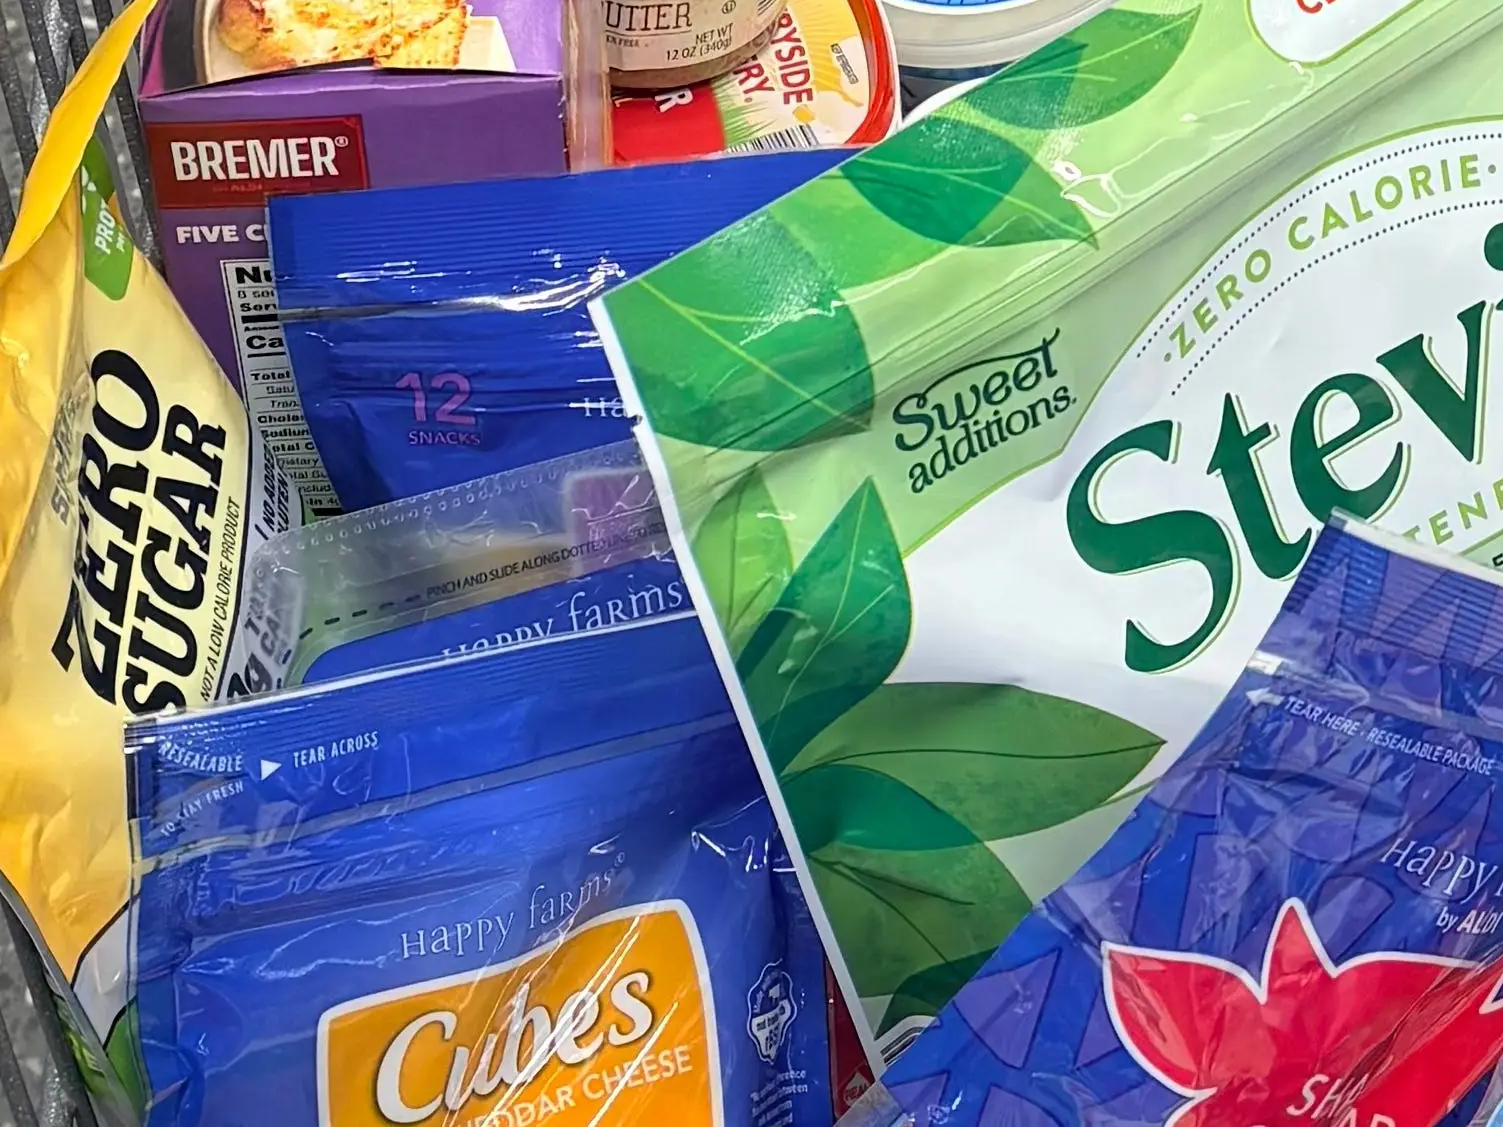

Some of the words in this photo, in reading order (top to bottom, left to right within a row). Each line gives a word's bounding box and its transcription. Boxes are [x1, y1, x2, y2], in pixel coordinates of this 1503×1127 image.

[666, 47, 681, 61] 12
[682, 45, 698, 59] OZ
[695, 31, 717, 45] NET
[718, 22, 734, 41] WT
[170, 135, 340, 182] BREMER
[175, 224, 239, 244] FIVE
[1169, 245, 1275, 361] ZERO
[1286, 151, 1484, 254] CALORIE
[394, 370, 477, 427] 12
[891, 327, 1063, 453] Sweet
[408, 430, 481, 446] SNACKS
[51, 348, 162, 707] ZERO
[225, 496, 241, 566] PRODUCT
[122, 403, 228, 720] SUGAR
[425, 580, 462, 599] PINCH
[462, 573, 488, 590] AND
[489, 562, 521, 582] SLIDE
[521, 551, 560, 570] ALONG
[217, 567, 234, 629] CALORIE
[211, 627, 226, 659] LOW
[200, 673, 214, 702] NOT
[157, 736, 244, 773] RESEALABLE
[292, 746, 327, 769] TEAR
[330, 729, 380, 760] ACROSS
[1285, 694, 1322, 726] TEAR
[1322, 707, 1362, 739] HERE
[1366, 726, 1443, 765] RESEALABLE
[1441, 746, 1498, 778] PACKAGE
[159, 821, 174, 838] TO
[204, 780, 245, 810] FRESH
[1435, 906, 1458, 933] by
[1459, 905, 1502, 936] ALDI
[377, 964, 654, 1124] Cubes
[581, 1043, 695, 1101] CHEESE
